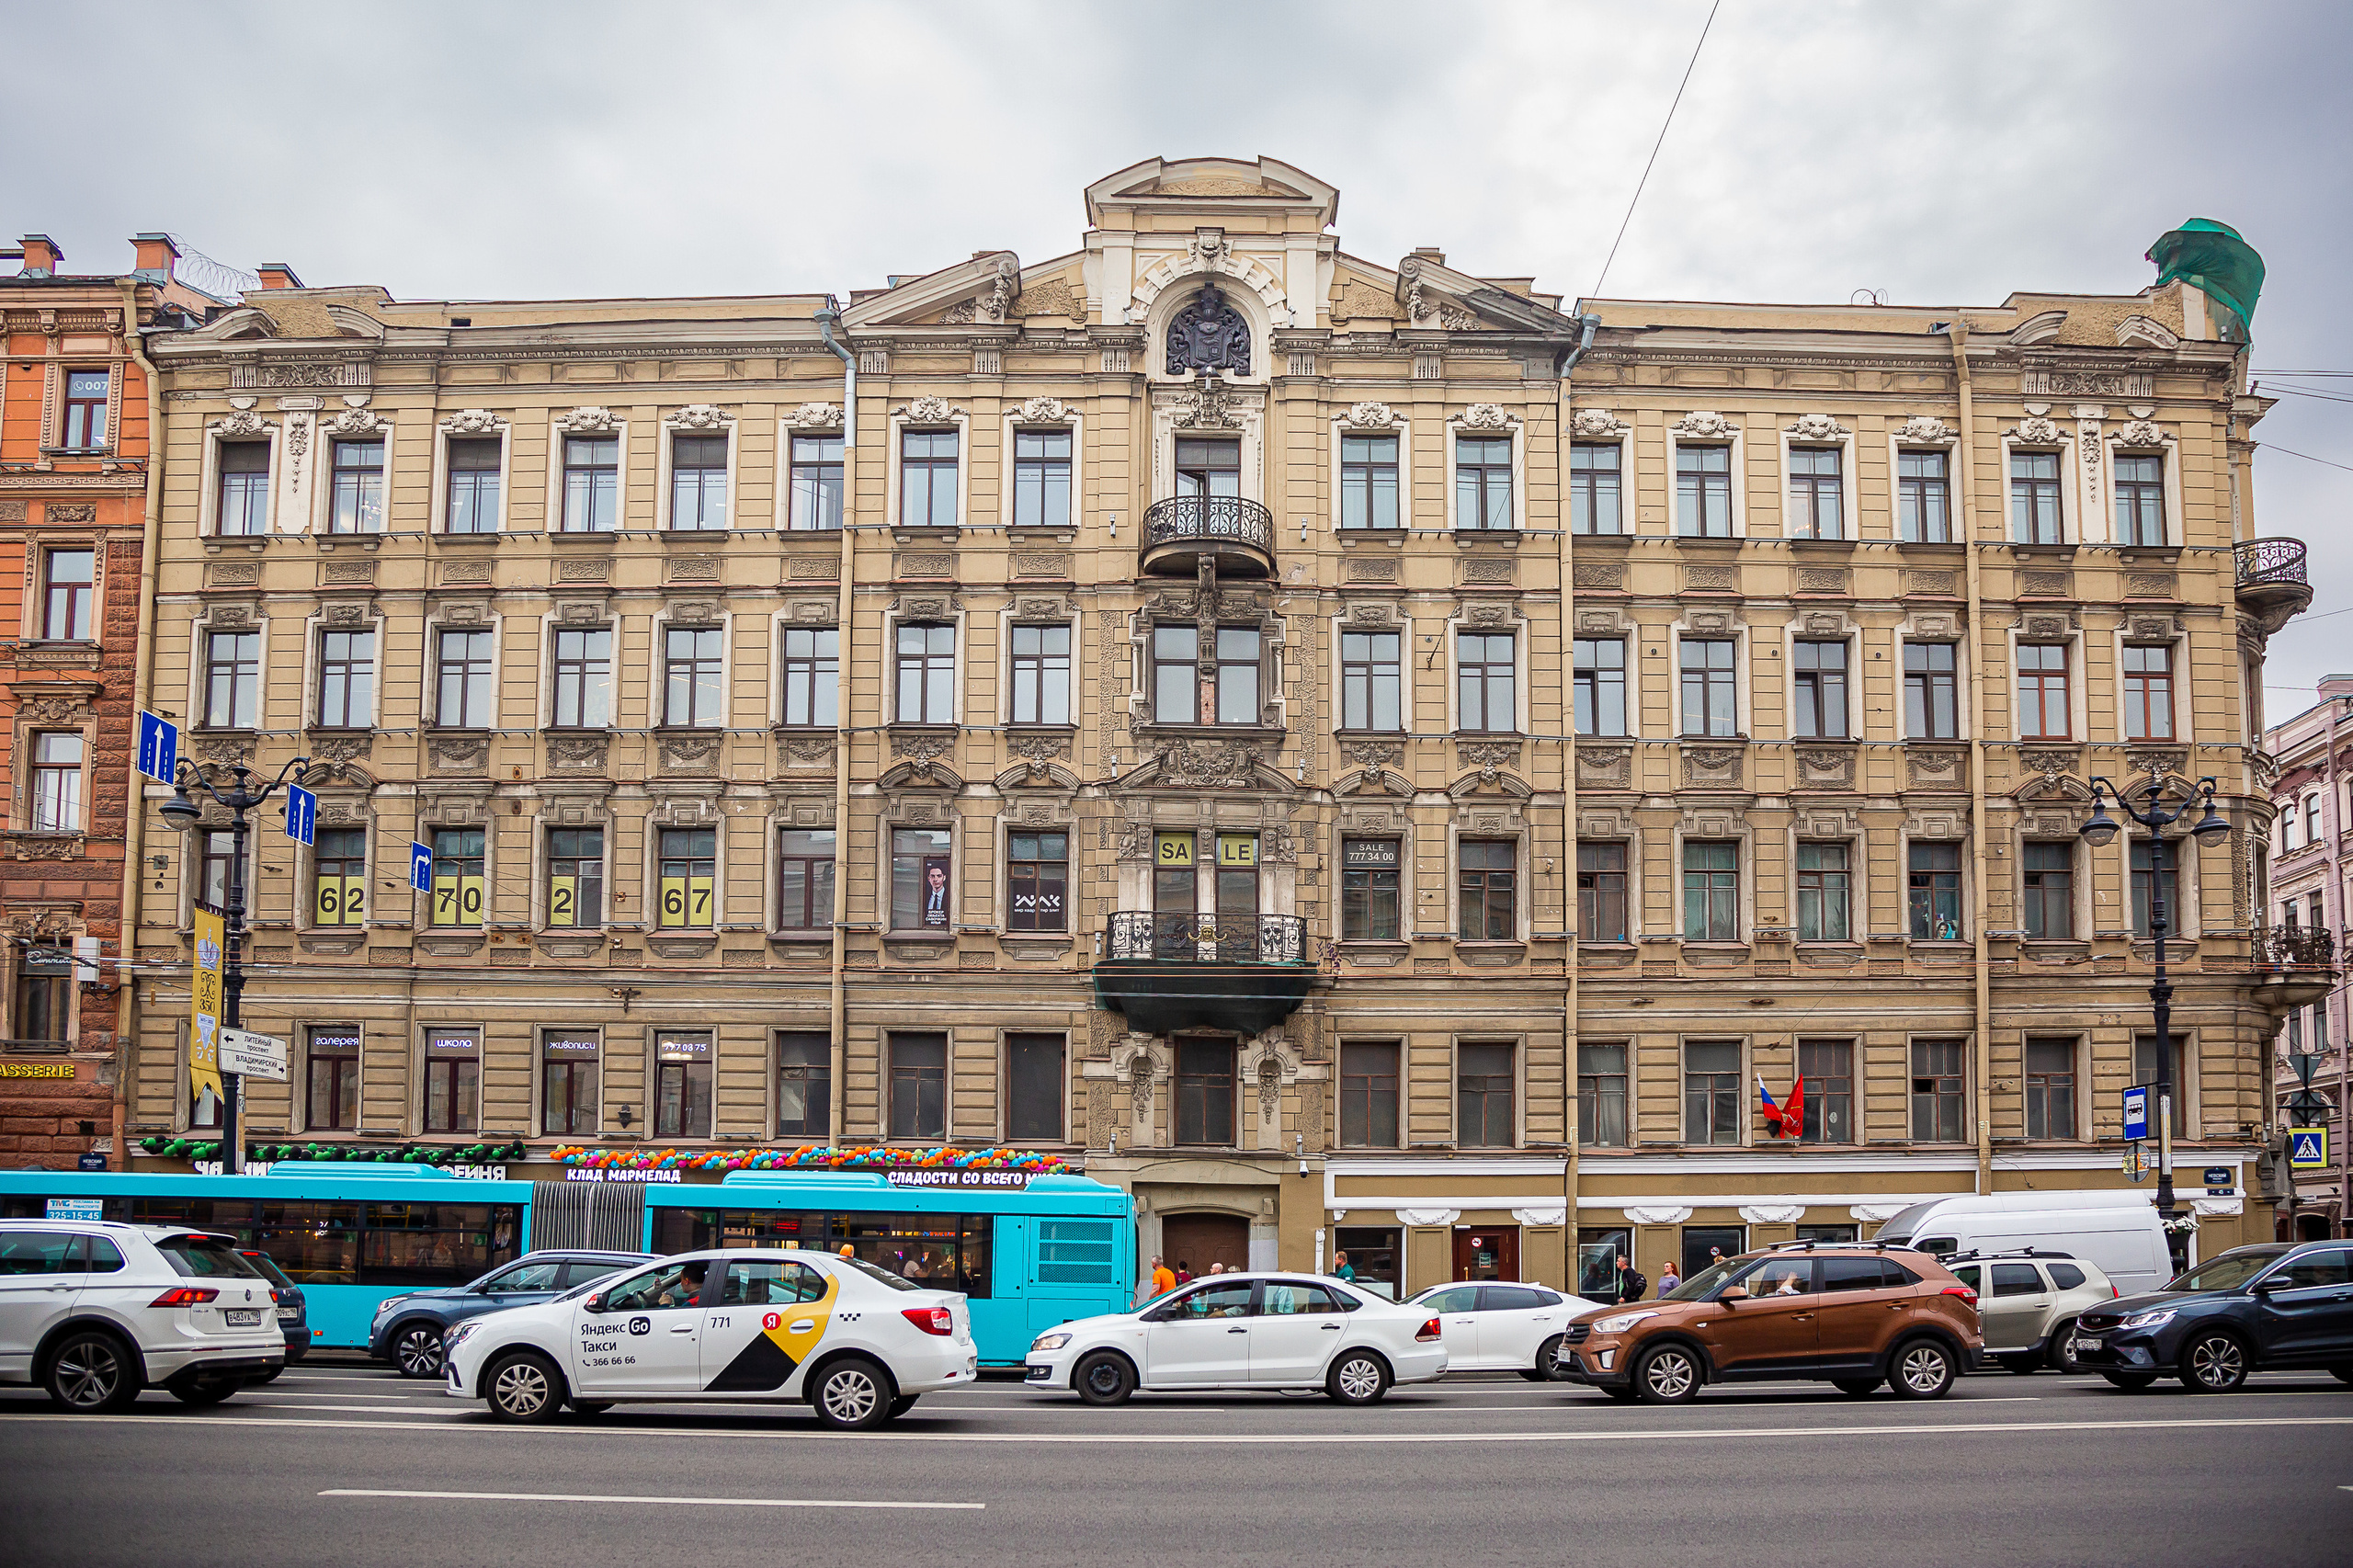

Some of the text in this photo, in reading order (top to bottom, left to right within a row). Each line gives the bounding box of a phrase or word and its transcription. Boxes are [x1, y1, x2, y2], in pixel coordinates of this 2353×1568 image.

[85, 381, 108, 391] 007
[1161, 842, 1251, 861] SA LE
[1348, 852, 1395, 862] 777 34 00
[553, 888, 572, 913] 2
[664, 888, 711, 915] 67
[199, 999, 216, 1013] 350
[244, 1035, 272, 1048] ЛИТЕЙНЫЙ
[315, 1037, 359, 1048] галерея
[435, 1039, 472, 1048] школа
[549, 1040, 596, 1051] живописи
[246, 1044, 269, 1054] проспект
[235, 1054, 278, 1069] ВЛАДИМИРСКИЙ
[245, 1064, 269, 1074] проспект
[565, 1168, 682, 1183] КЛАД МАРМЕЛАД
[887, 1171, 959, 1186] СЛАДОСТИ
[961, 1171, 980, 1185] СО
[982, 1172, 1023, 1186] ВСЕГО
[49, 1210, 100, 1221] 325-15-45
[710, 1316, 731, 1329] 771
[766, 1314, 777, 1327] Я
[581, 1319, 649, 1336] Яндекс Go
[581, 1340, 618, 1353] Такси
[592, 1356, 636, 1368] 366 66 66
